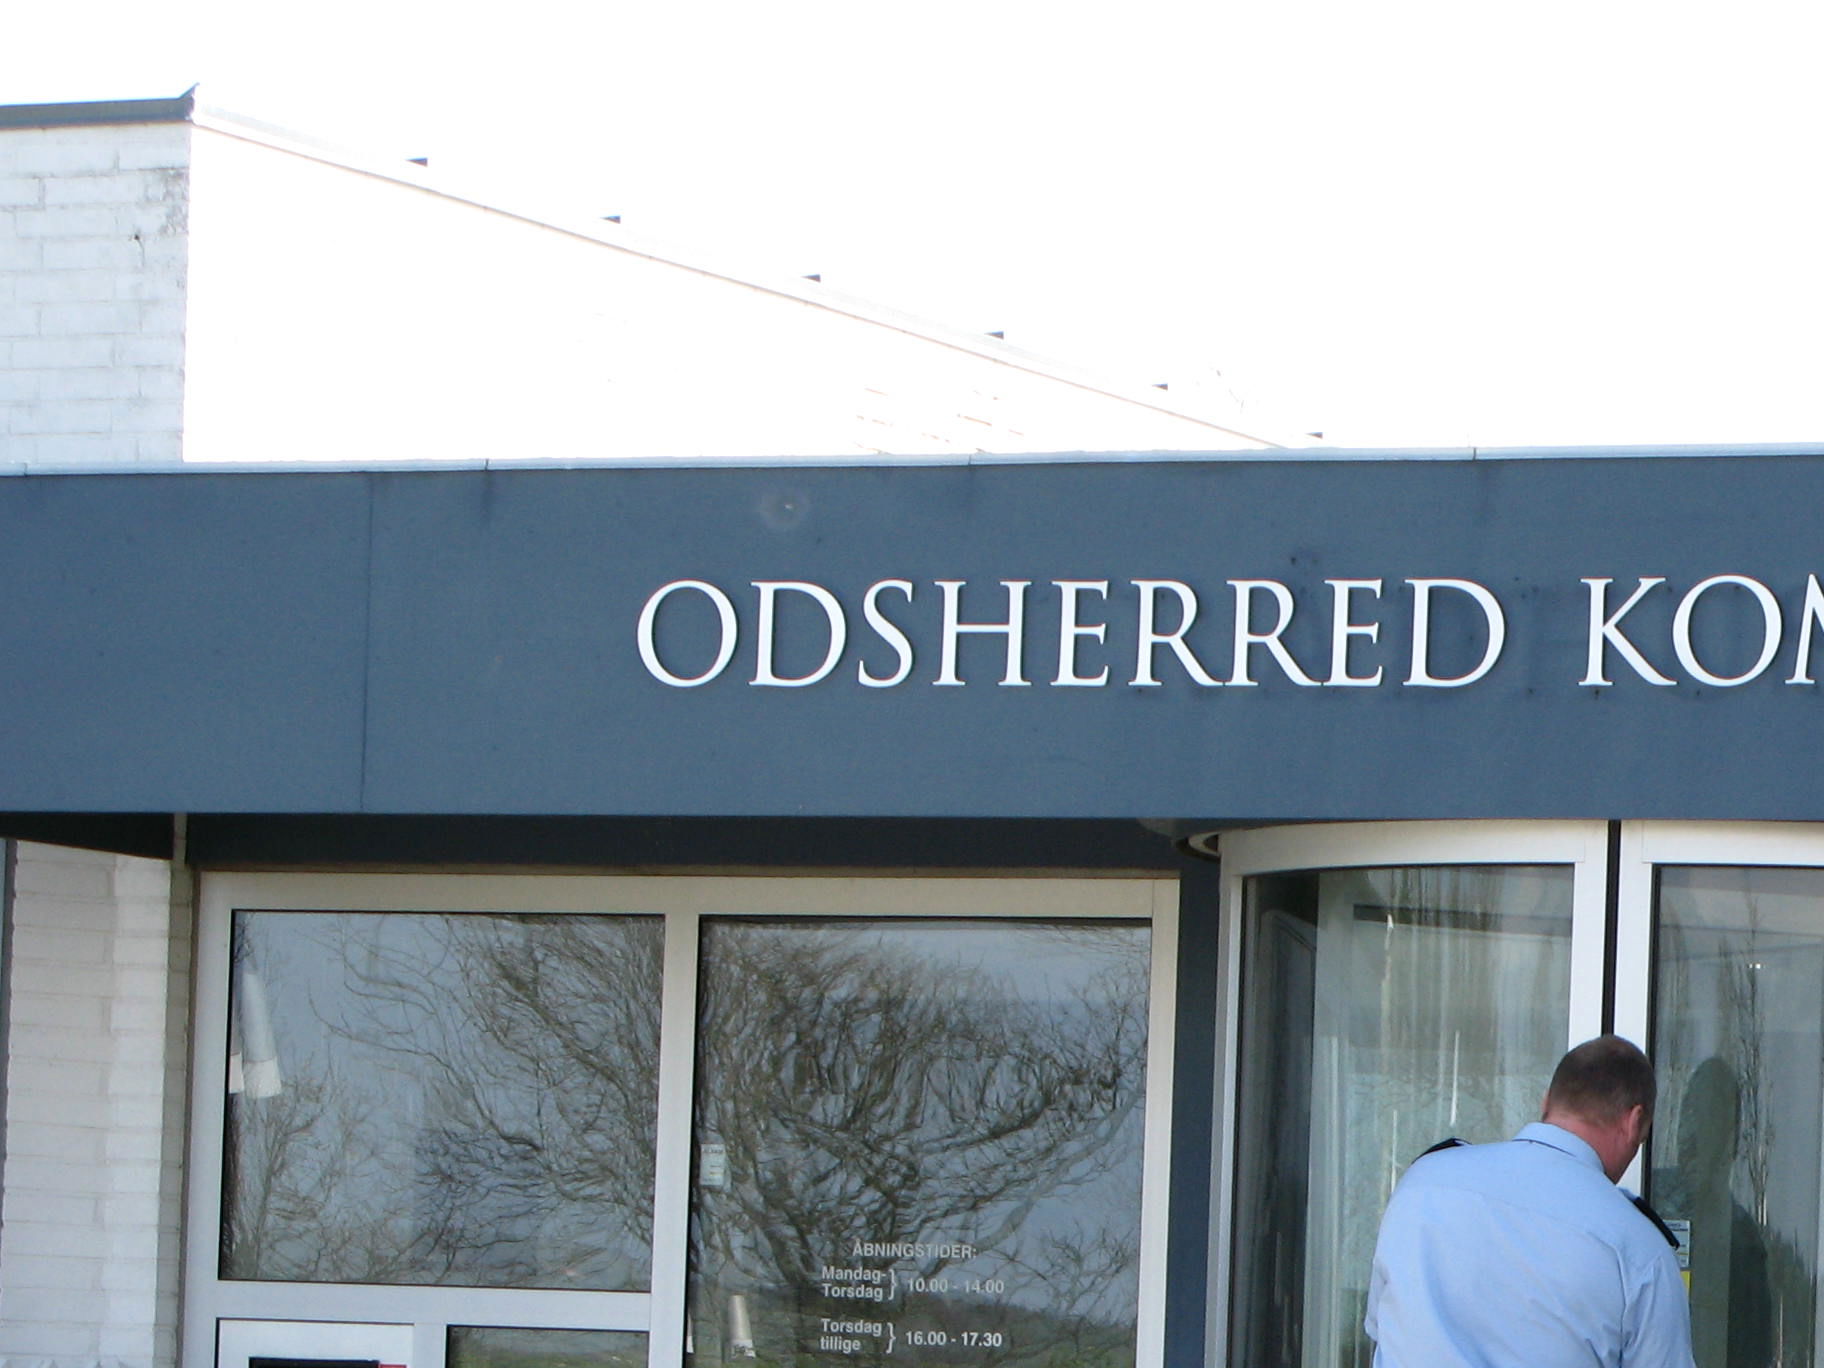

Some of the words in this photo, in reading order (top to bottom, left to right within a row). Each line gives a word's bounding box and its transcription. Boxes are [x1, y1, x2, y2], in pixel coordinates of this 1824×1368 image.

[637, 579, 1506, 688] ODSHERRED
[852, 1238, 977, 1259] ÅBNINGSTIDER:
[821, 1283, 884, 1302] Torsdag
[907, 1277, 948, 1293] 10.00
[964, 1279, 1005, 1294] 14.00
[820, 1318, 882, 1337] Torsdag
[819, 1336, 862, 1354] tillige
[905, 1331, 947, 1346] 16.00
[961, 1332, 1003, 1347] 17.30
